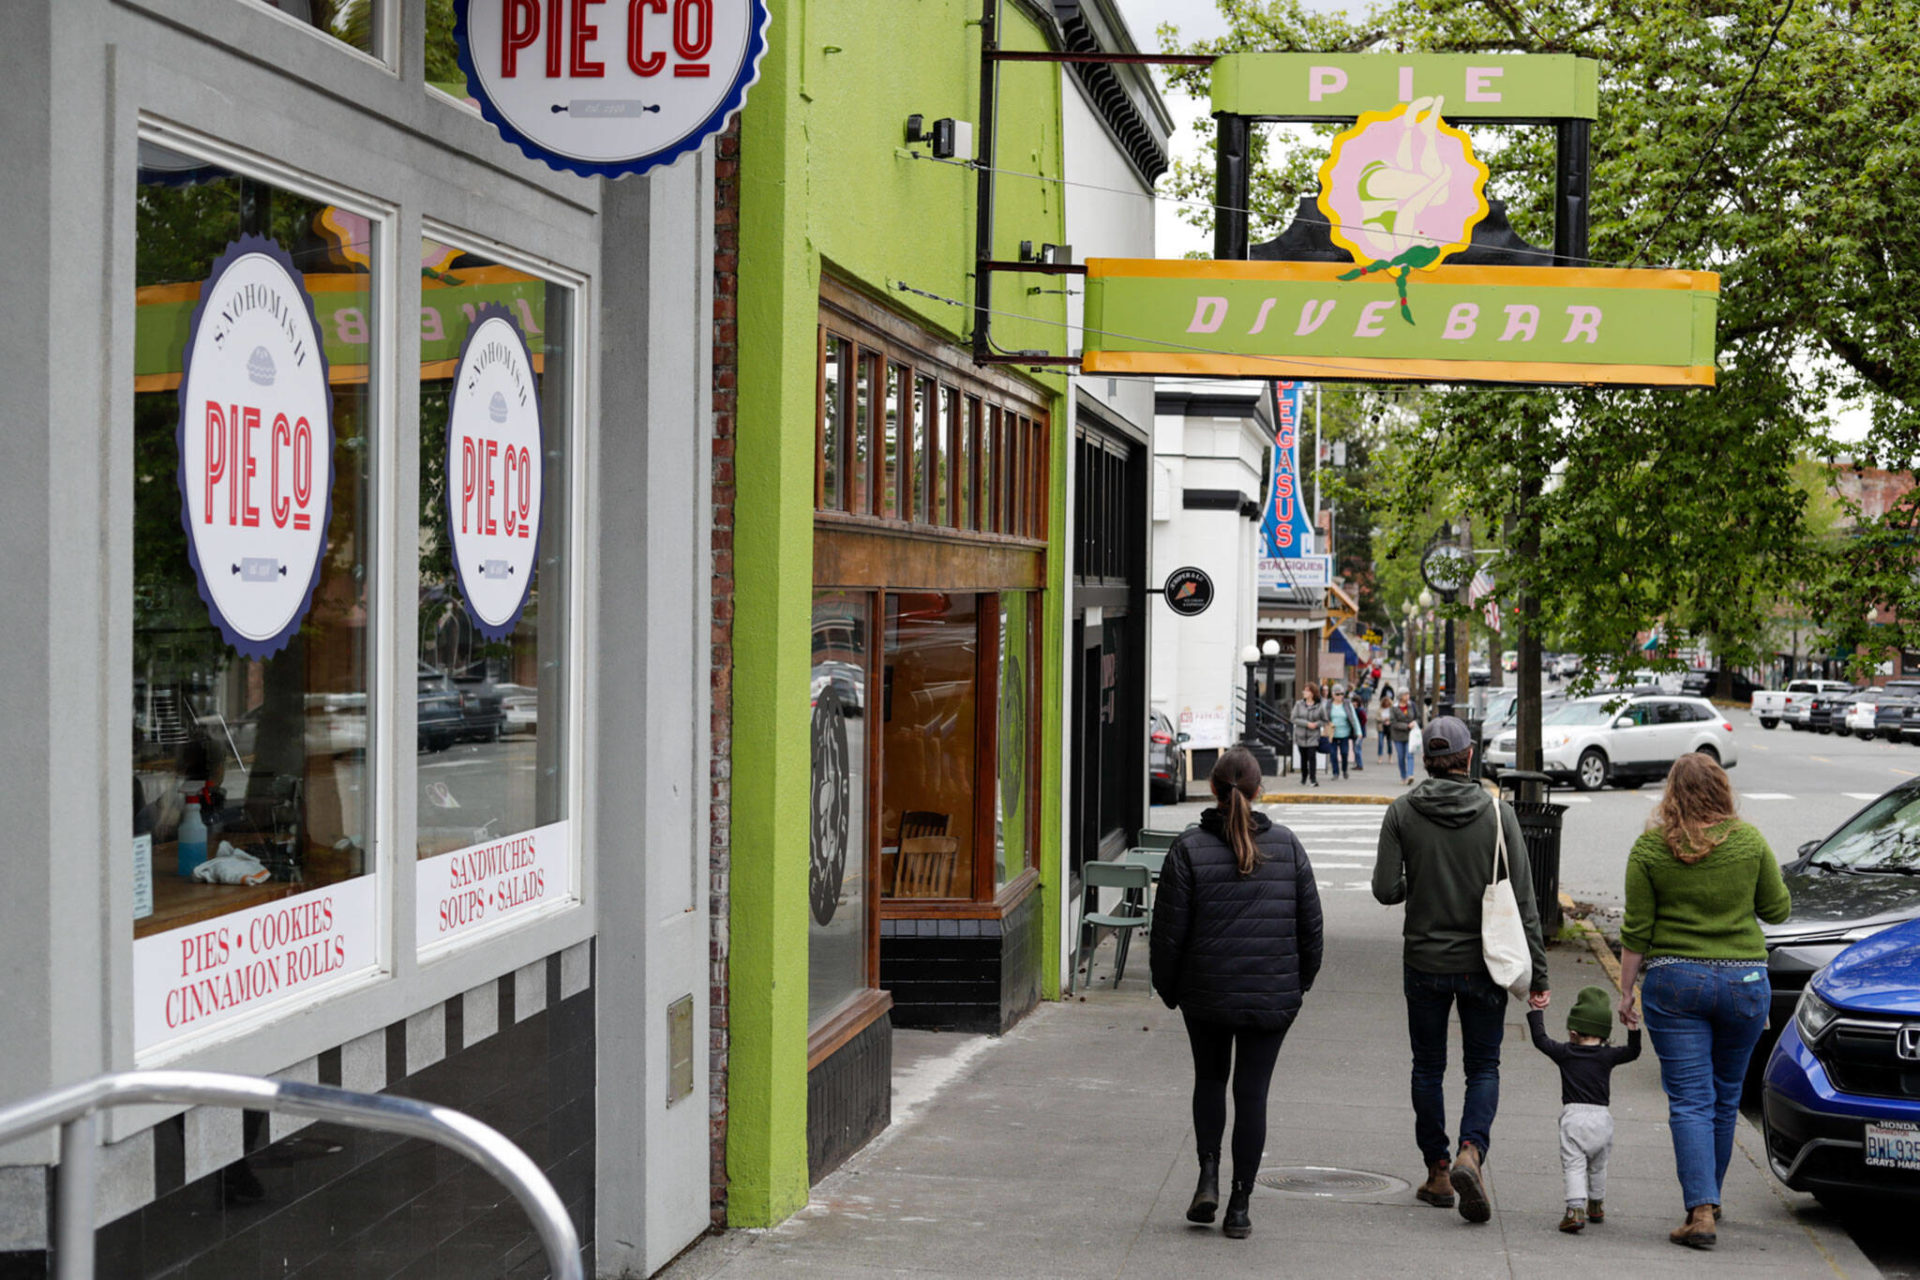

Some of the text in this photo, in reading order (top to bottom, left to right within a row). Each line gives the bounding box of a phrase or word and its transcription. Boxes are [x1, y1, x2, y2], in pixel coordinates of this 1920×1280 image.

[501, 0, 604, 78] PIE
[1308, 65, 1504, 103] PIE
[1185, 296, 1602, 345] DIVE BAR
[204, 400, 261, 528] PIE
[461, 435, 498, 536] PIE
[1275, 381, 1294, 547] PEGASUS
[1258, 560, 1323, 571] STALGIQUES
[450, 835, 535, 889] SANDWICHES
[440, 868, 544, 932] SOUPS SALADS
[181, 897, 333, 978] PIES COOKIES
[165, 934, 345, 1029] CINNAMON ROLLS
[1865, 1157, 1895, 1167] GRAYS
